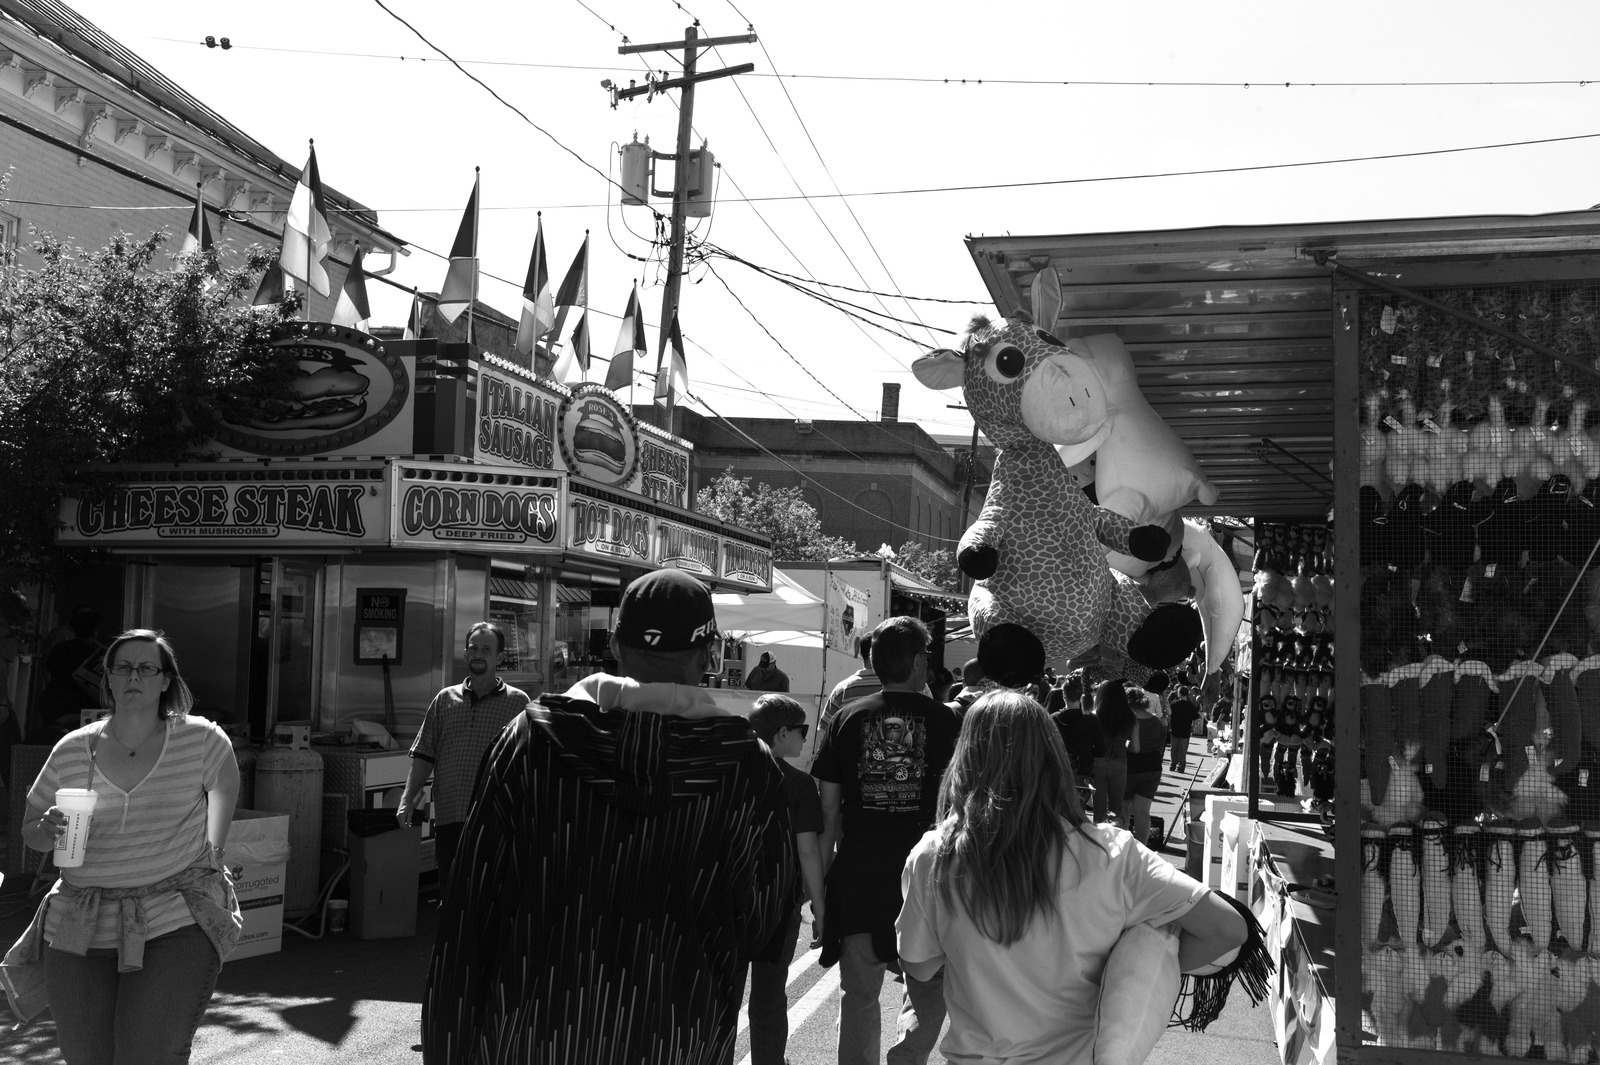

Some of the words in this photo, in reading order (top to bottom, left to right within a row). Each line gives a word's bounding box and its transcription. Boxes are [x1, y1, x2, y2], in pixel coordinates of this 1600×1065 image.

[479, 373, 556, 444] ITALIAN
[588, 403, 615, 422] ROSE'S
[478, 418, 555, 470] SAUSAGE
[639, 440, 687, 490] CHEESE
[77, 485, 228, 537] CHEESE
[233, 485, 366, 537] STEAK
[402, 485, 481, 535] CORN
[482, 491, 557, 543] DOGS
[640, 470, 685, 509] STEAK
[169, 527, 197, 535] WITH
[199, 527, 269, 535] MUSHROOMS
[445, 530, 478, 539] DEEP
[480, 531, 516, 540] FRIED
[574, 499, 609, 546] HOT
[611, 508, 650, 560] DOGS
[363, 607, 397, 620] SMOKING
